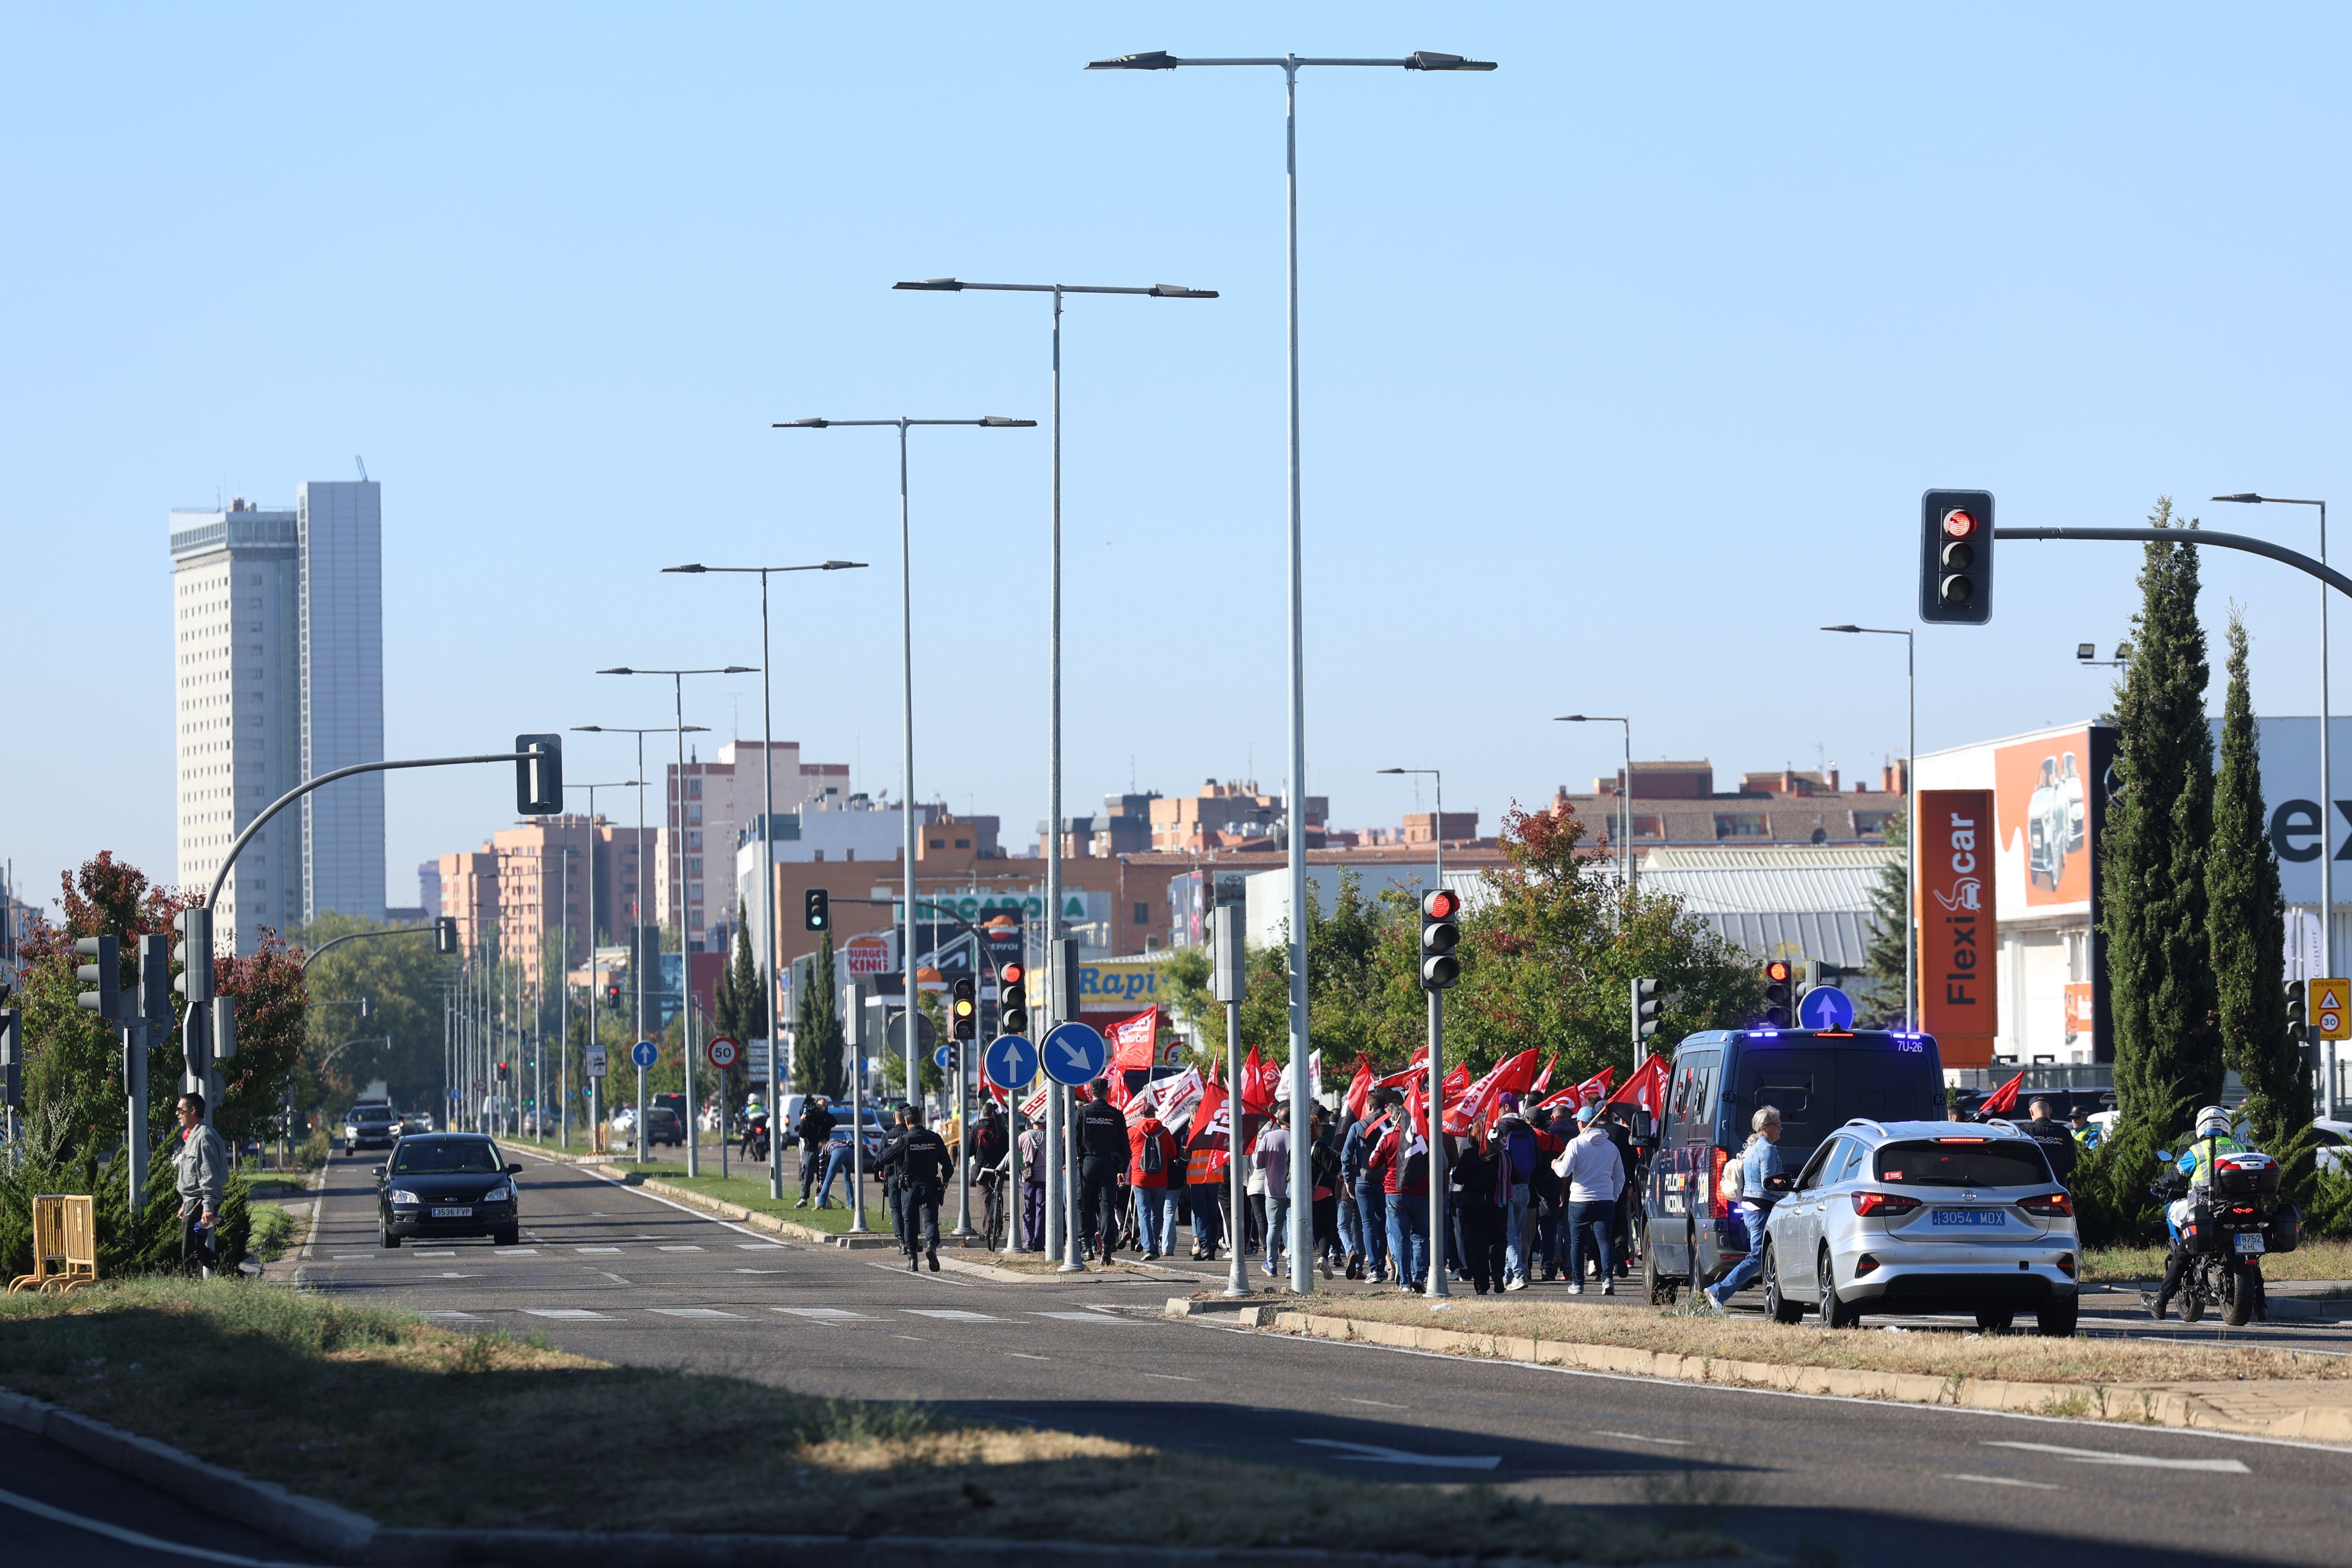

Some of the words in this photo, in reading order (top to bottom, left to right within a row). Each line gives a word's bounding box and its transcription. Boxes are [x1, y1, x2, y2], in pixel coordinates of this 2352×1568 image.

[1951, 813, 1976, 873] car
[988, 942, 1019, 951] EPSOL
[849, 950, 888, 958] BURGER
[849, 959, 888, 971] KING
[1946, 917, 1976, 1004] Flexi
[715, 1048, 731, 1058] 50
[1897, 1041, 1923, 1053] 7U-26
[1165, 1109, 1182, 1126] Castilla
[1665, 1173, 1681, 1191] POLICIA
[1665, 1195, 1685, 1213] NACIONAL
[1942, 1212, 1973, 1223] 3054
[1980, 1212, 2003, 1224] MDX
[2241, 1235, 2262, 1243] 8752
[2243, 1243, 2258, 1251] KHL
